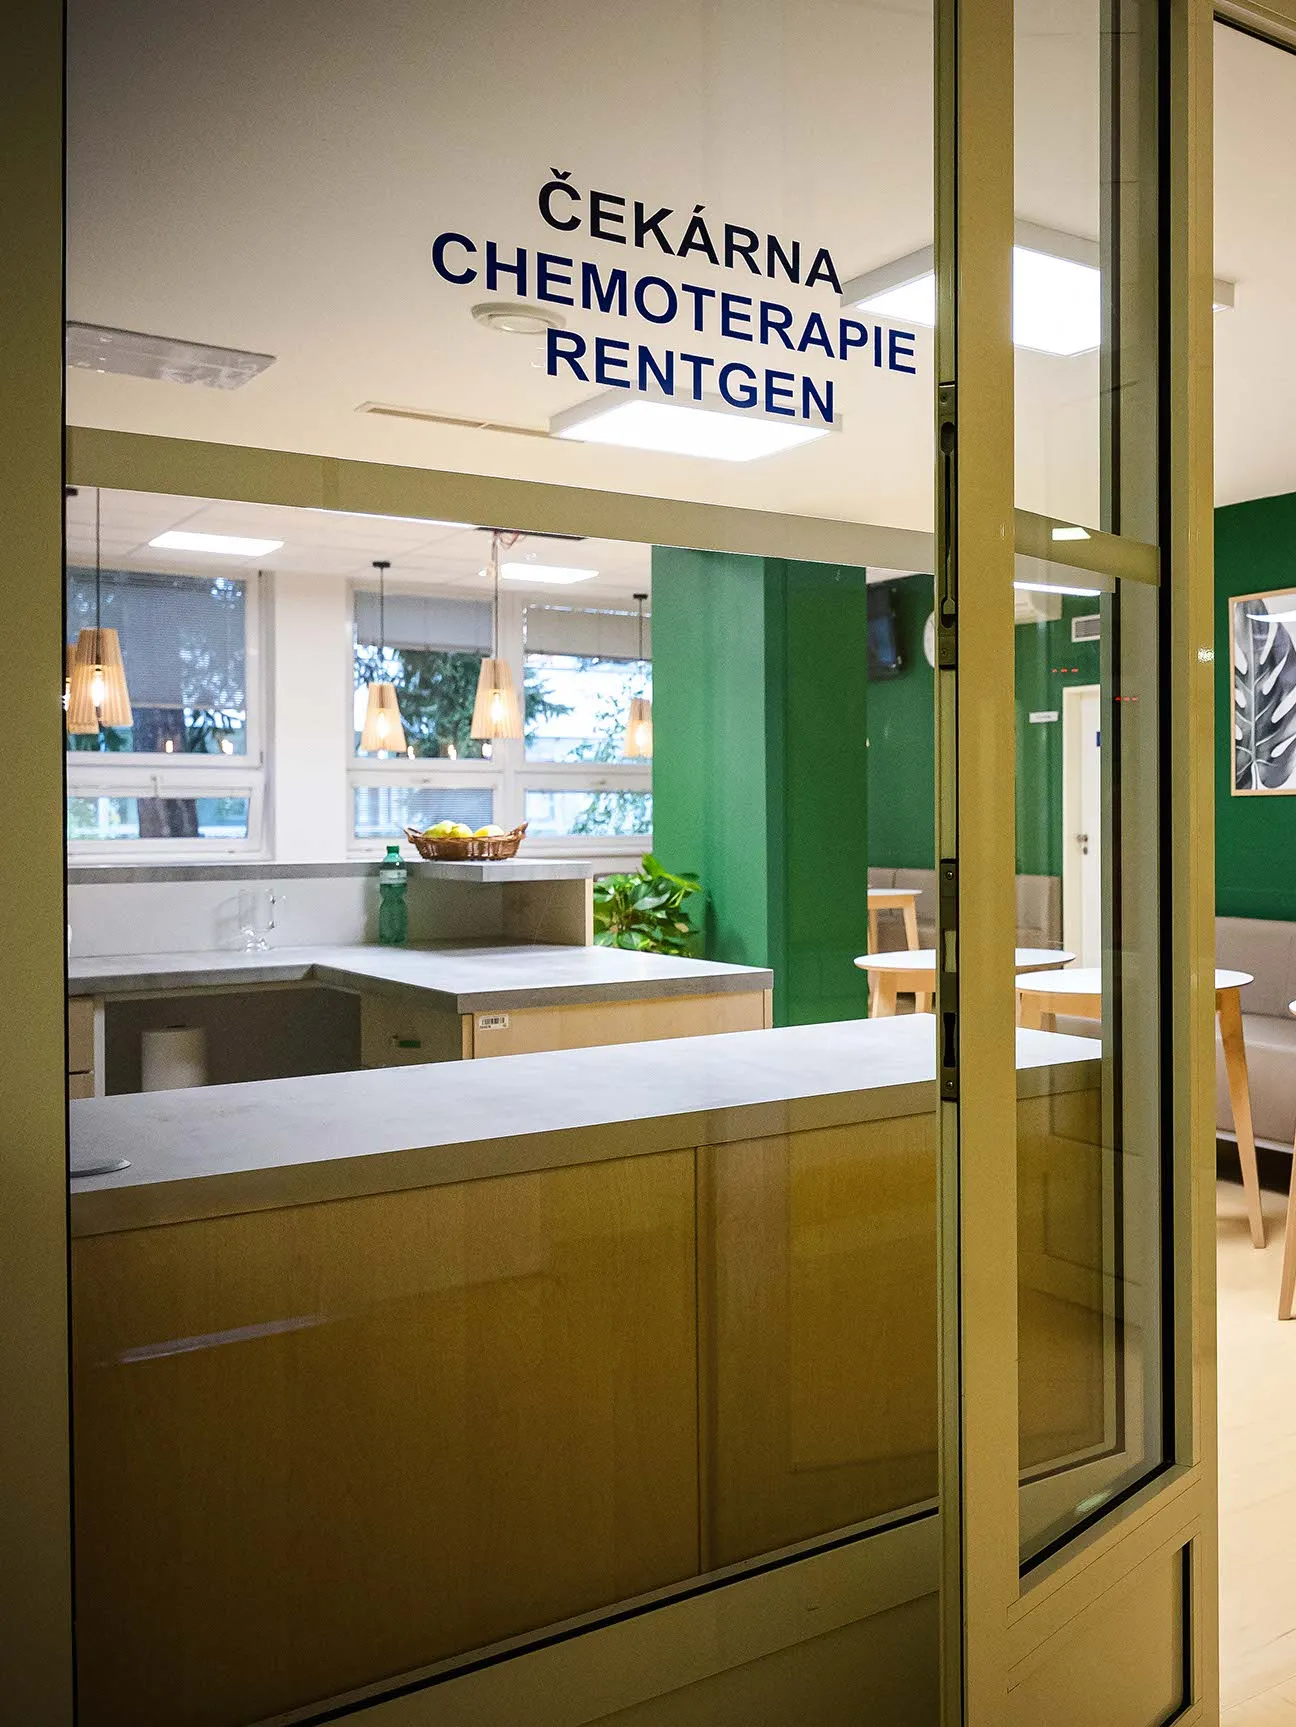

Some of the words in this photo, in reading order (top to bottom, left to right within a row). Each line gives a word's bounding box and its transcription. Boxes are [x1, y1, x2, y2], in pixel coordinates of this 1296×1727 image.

[538, 166, 844, 295] ČEKÁRNA
[432, 232, 917, 375] CHEMOTERAPIE
[547, 327, 834, 423] RENTGEN
